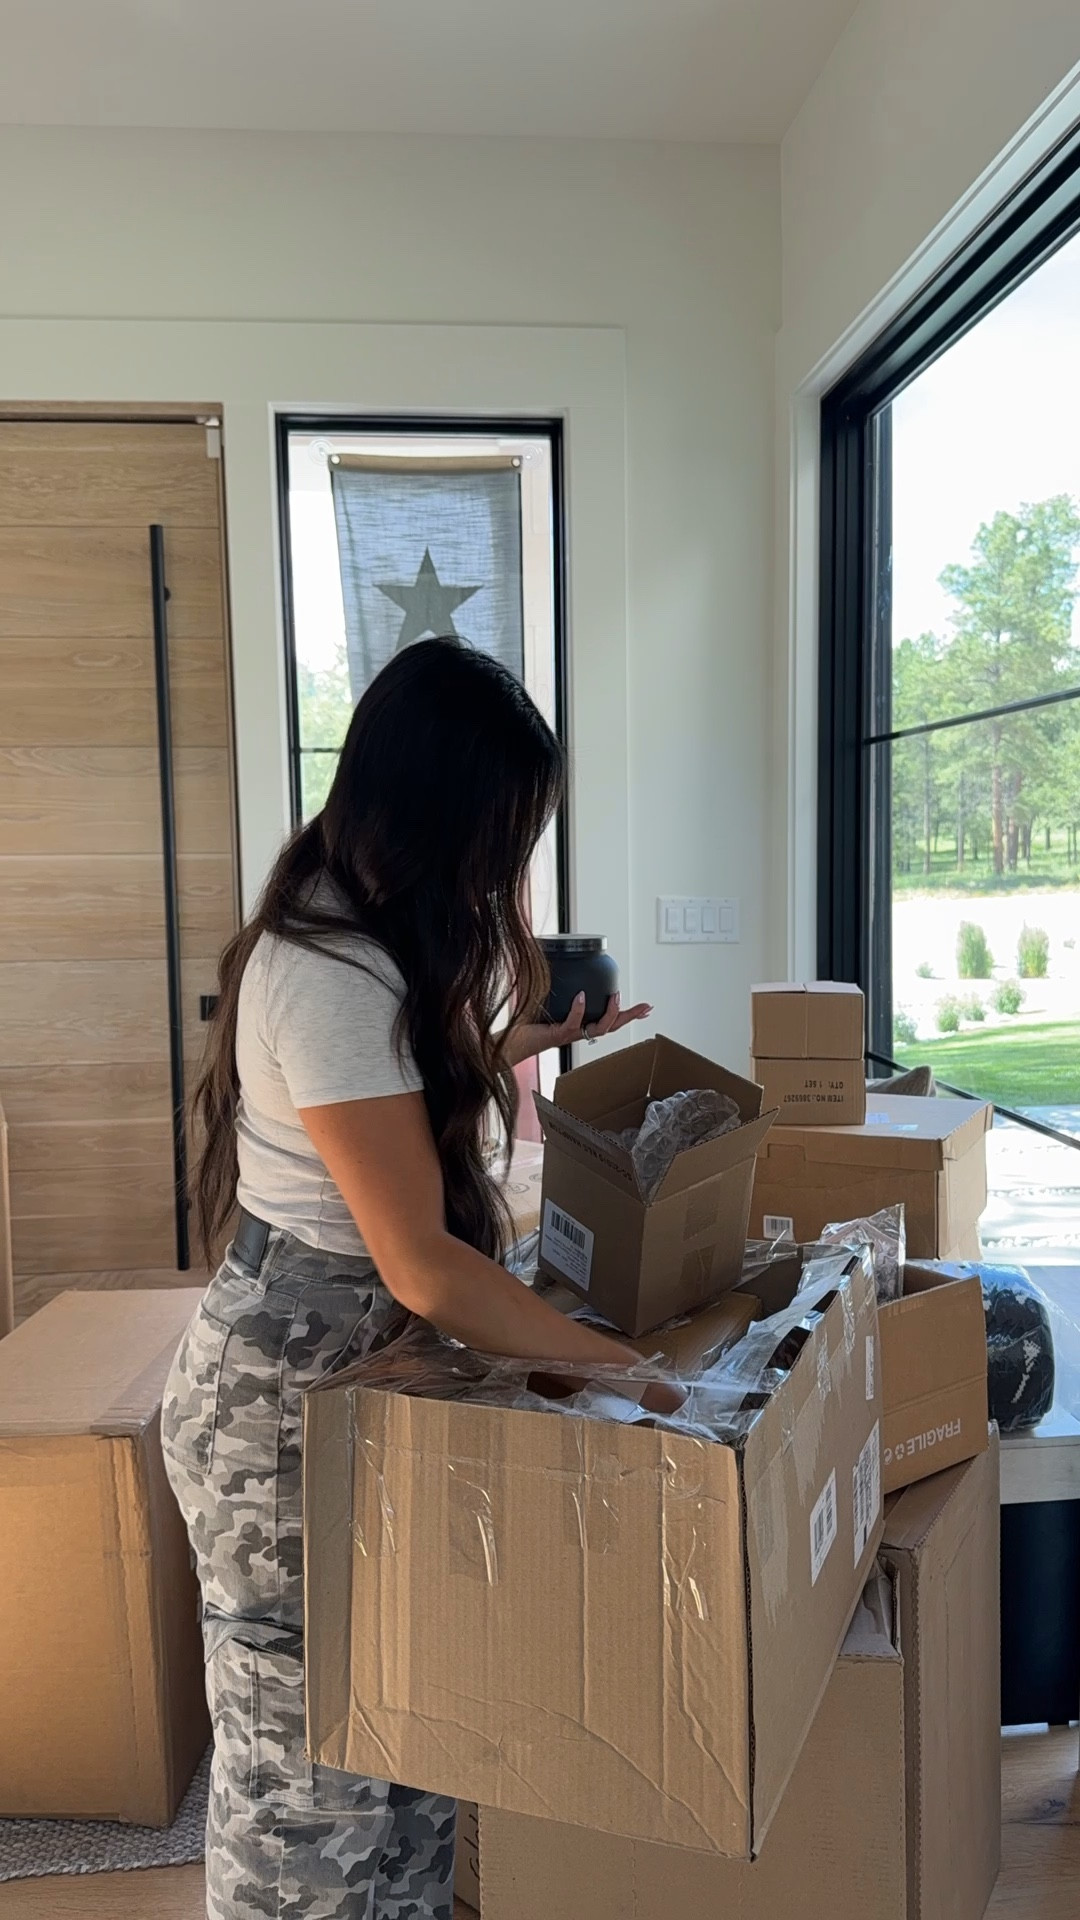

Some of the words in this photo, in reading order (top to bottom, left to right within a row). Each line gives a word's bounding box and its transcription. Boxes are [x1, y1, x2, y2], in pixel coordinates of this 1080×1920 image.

[804, 1080, 817, 1088] SET
[829, 1081, 844, 1089] QTY:
[827, 1094, 844, 1103] ITEM
[906, 1418, 961, 1456] FRAGILE
